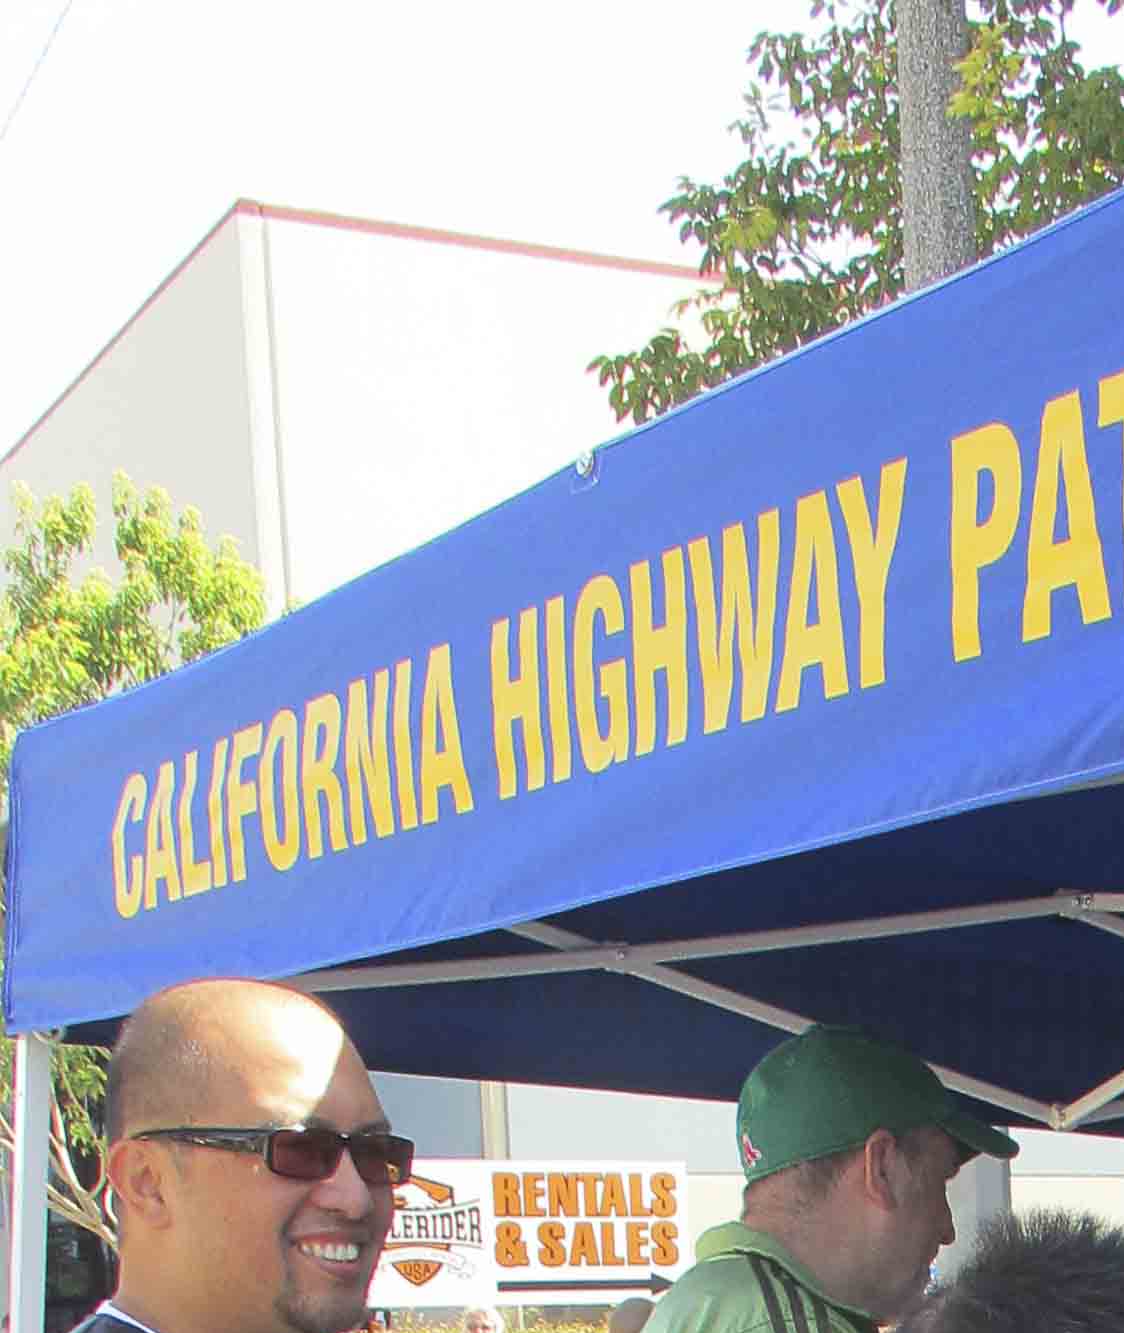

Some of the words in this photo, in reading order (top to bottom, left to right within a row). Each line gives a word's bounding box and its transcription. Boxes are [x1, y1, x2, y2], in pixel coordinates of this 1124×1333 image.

[111, 640, 475, 920] CALIFORNIA
[490, 456, 908, 801] HIGHWAY
[491, 1171, 678, 1217] RENTALS
[390, 1206, 482, 1243] LERIDER
[495, 1222, 530, 1266] &
[537, 1221, 680, 1267] SALES
